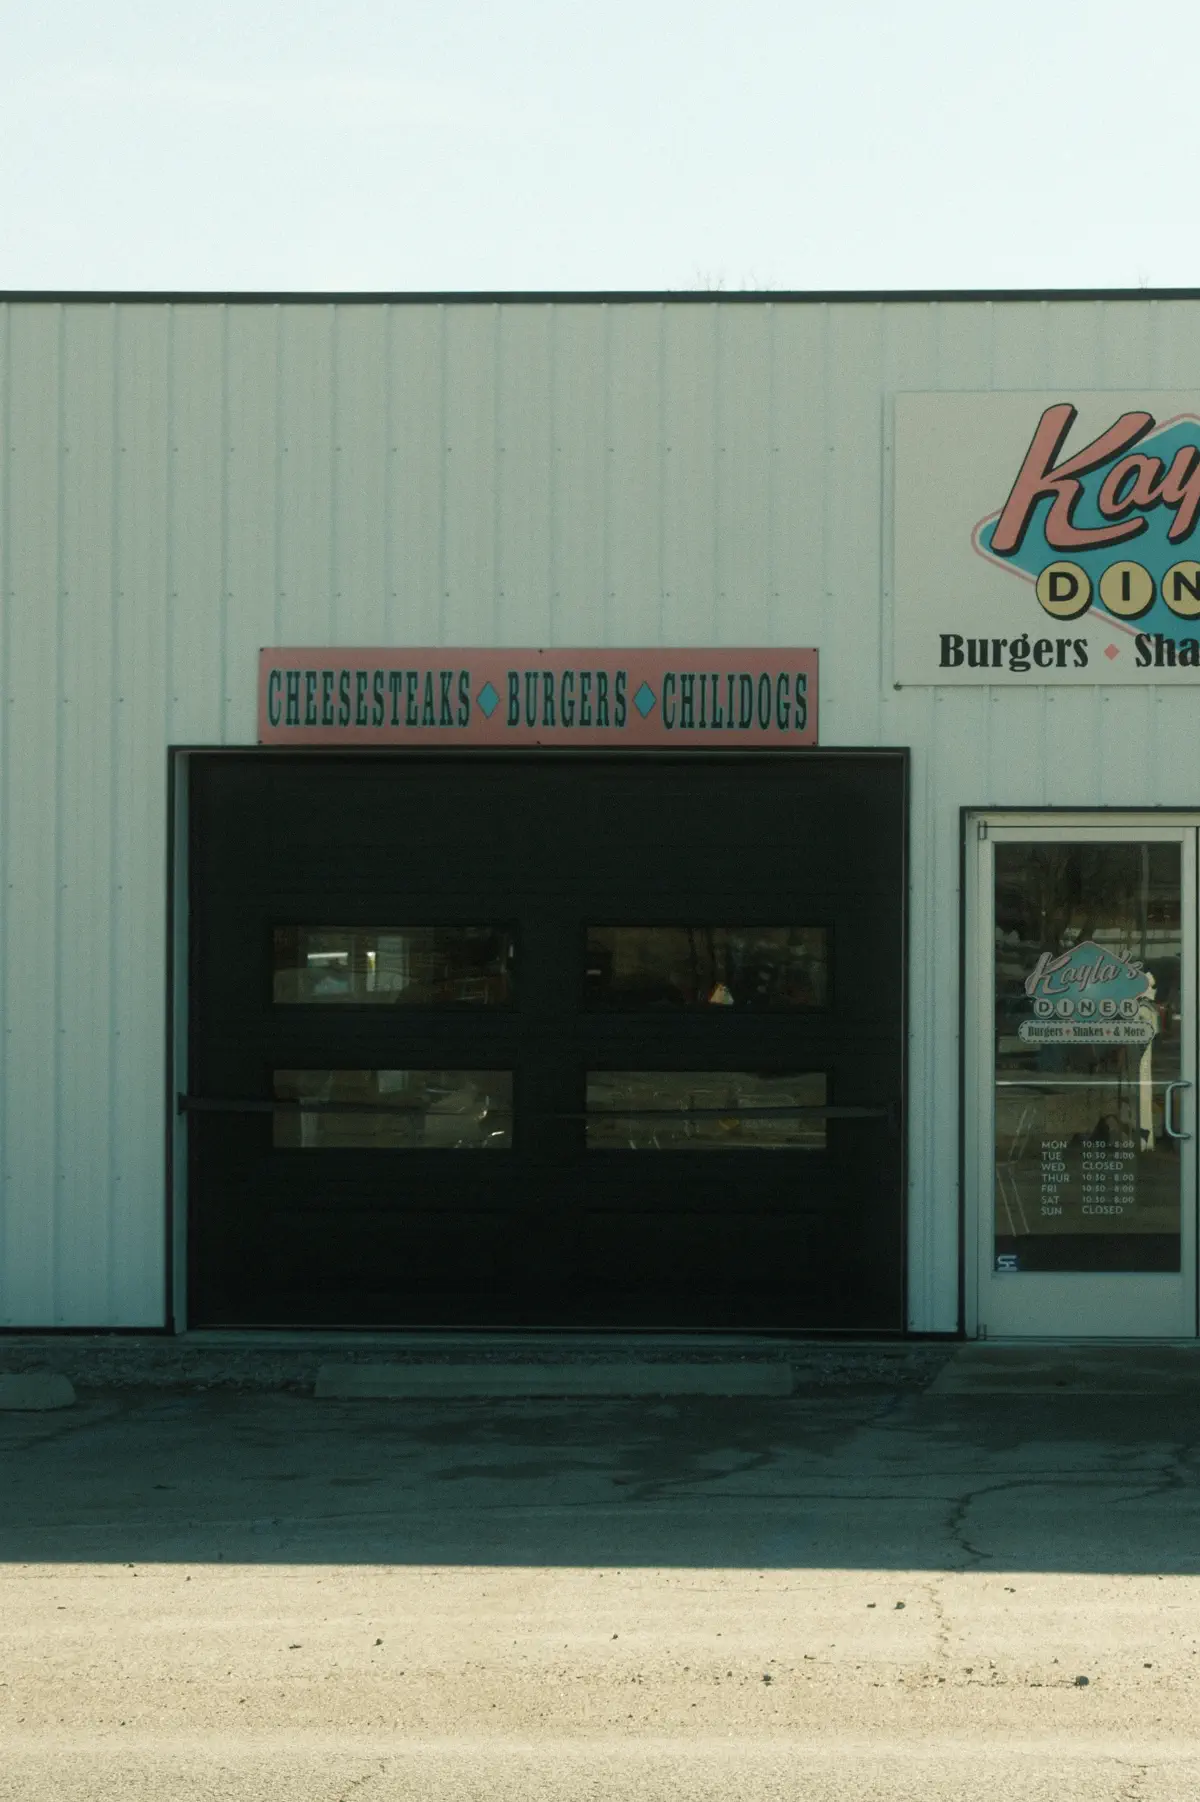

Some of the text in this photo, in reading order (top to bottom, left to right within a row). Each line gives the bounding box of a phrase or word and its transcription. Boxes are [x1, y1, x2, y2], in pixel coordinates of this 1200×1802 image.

[939, 633, 1089, 672] Burgers
[267, 670, 808, 730] CHEESESTEAKS BURGERS CHILIDOGS
[1028, 949, 1144, 995] Kayla's
[1038, 1001, 1133, 1013] DINER
[1028, 1026, 1145, 1037] Burgers Shakes & More
[1041, 1140, 1067, 1149] MON
[1042, 1151, 1062, 1161] TUE
[1041, 1161, 1124, 1171] WED CLOSED
[1042, 1174, 1070, 1183] THUR
[1041, 1184, 1057, 1193] FRI
[1041, 1196, 1060, 1205] SAT
[1041, 1205, 1124, 1216] SUN CLOSED
